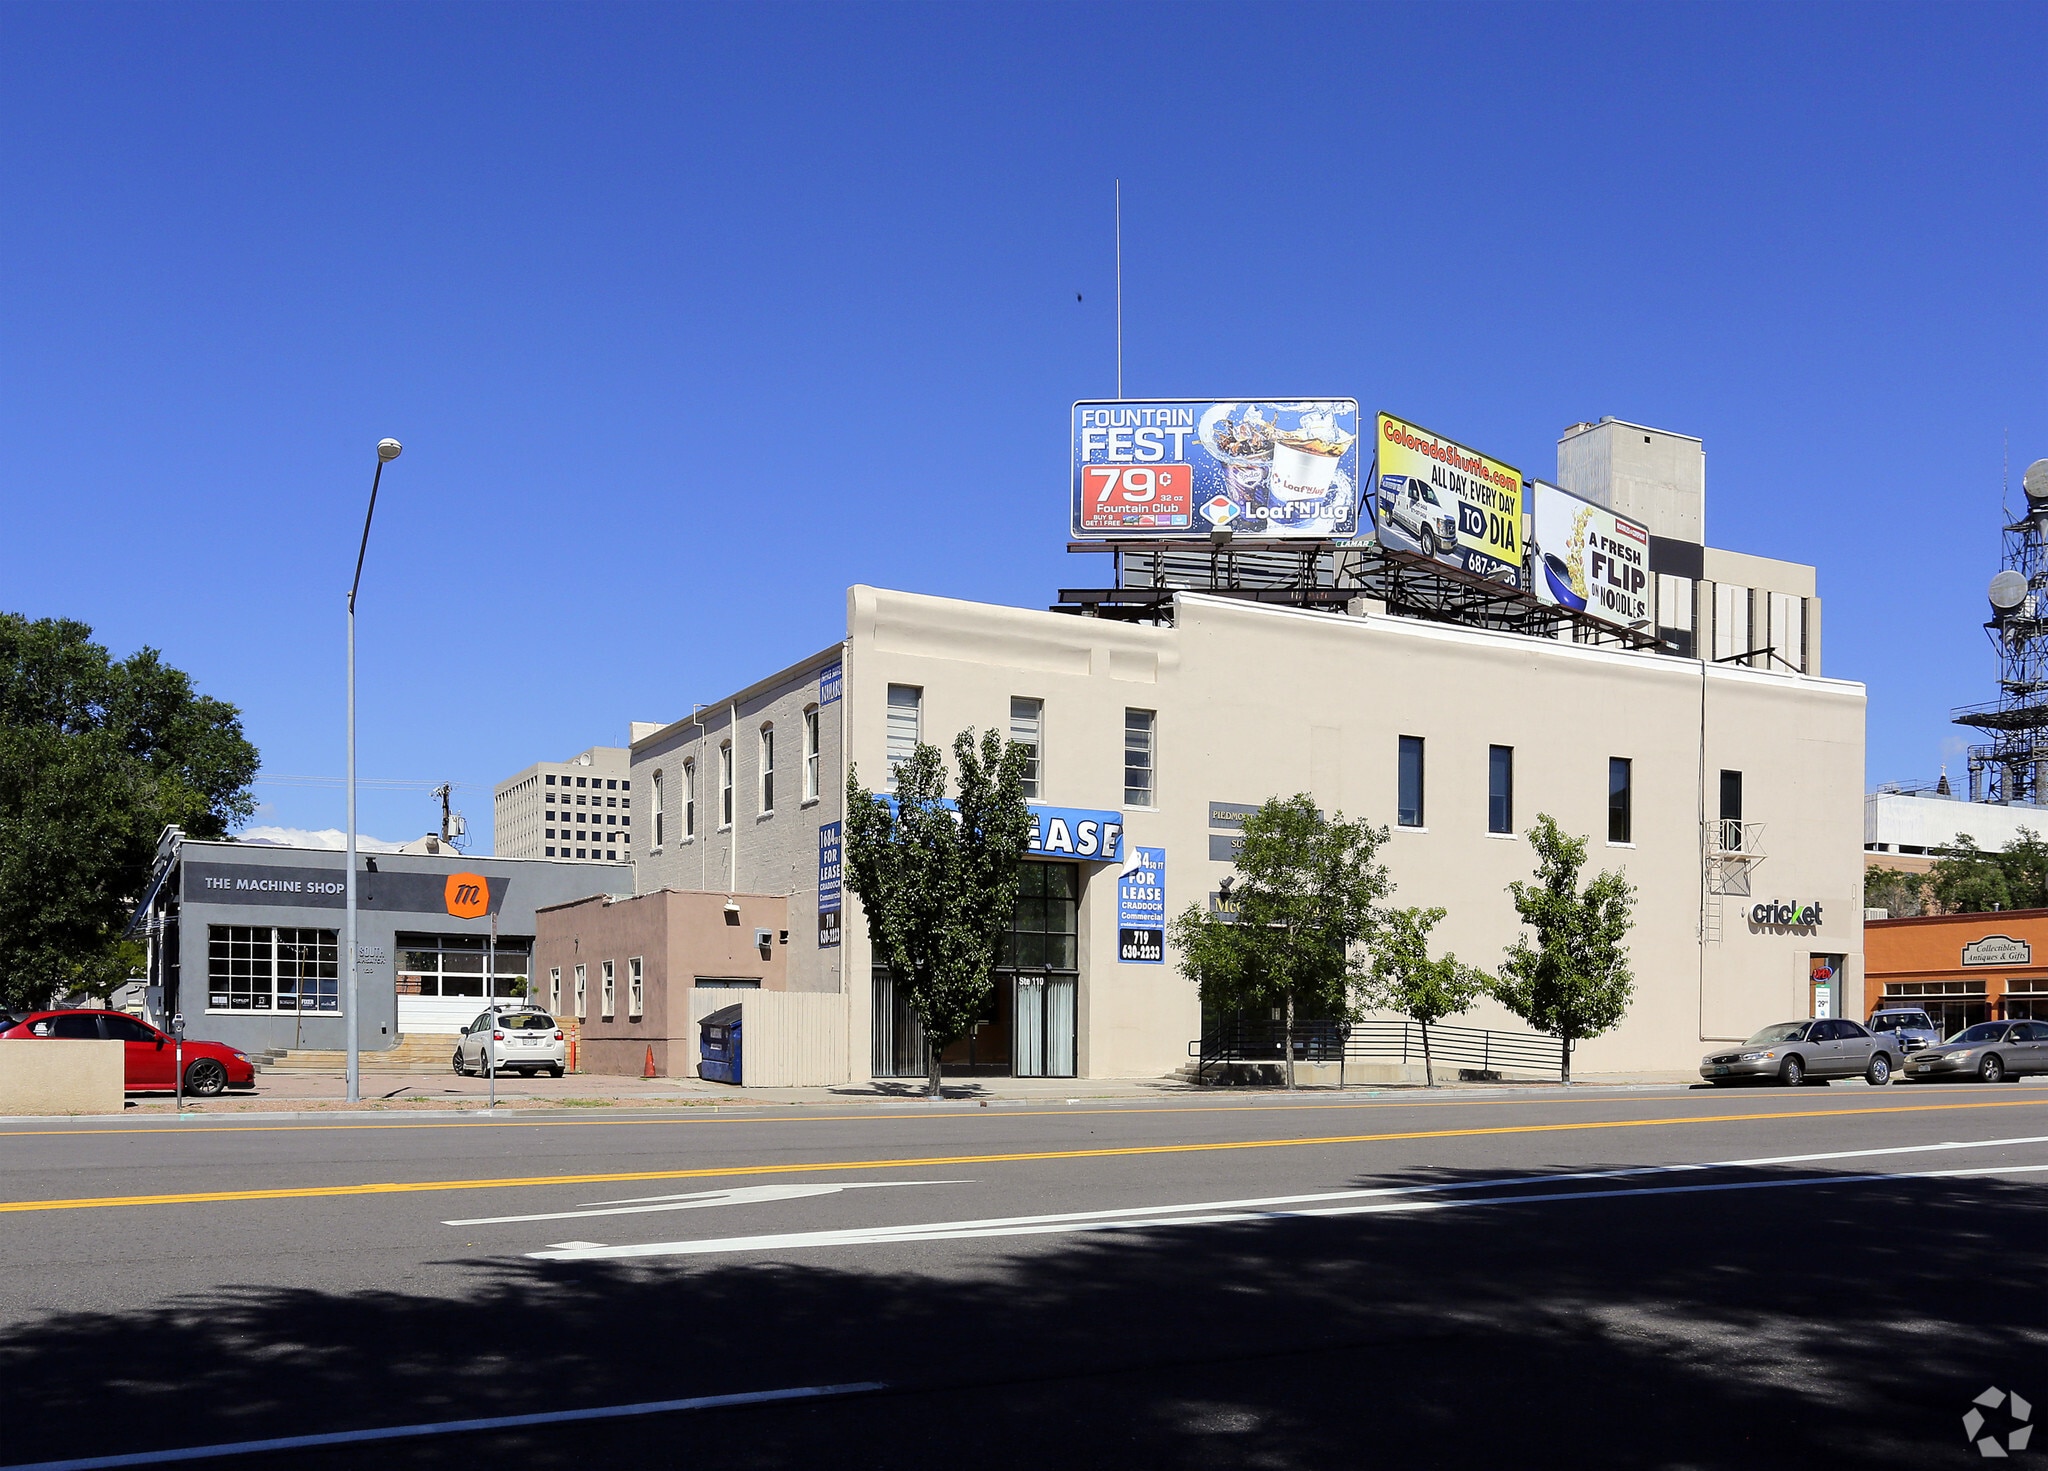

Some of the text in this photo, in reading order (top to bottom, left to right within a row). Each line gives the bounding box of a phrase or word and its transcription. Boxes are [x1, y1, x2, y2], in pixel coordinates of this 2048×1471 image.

[1081, 408, 1195, 428] FOUNTAIN
[1081, 426, 1195, 463] FEST
[1383, 419, 1518, 494] ColoradoShuttle.com
[1160, 494, 1172, 502] 32
[1431, 464, 1516, 517] ALL DAY, EVERY DAY
[1096, 503, 1179, 514] Fountain Club
[1104, 519, 1121, 527] FREE
[1463, 507, 1516, 554] TO DIA
[1340, 539, 1369, 548] LAMAR
[1588, 531, 1642, 566] A FRESH
[1591, 550, 1646, 595] FLIP
[1600, 585, 1646, 620] NOODLES
[1211, 809, 1256, 821] PIEDMOT
[1027, 814, 1123, 859] EASE
[823, 848, 838, 865] FOR
[820, 863, 841, 882] LEASE
[1128, 870, 1156, 885] FOR
[205, 877, 345, 895] THE MACHINE SHOP
[1122, 885, 1162, 901] LEASE
[1121, 901, 1163, 911] CRADDOCK
[1751, 899, 1824, 927] cricket
[1121, 911, 1163, 921] Commercial
[1133, 930, 1150, 945] 719
[1122, 944, 1161, 960] 630-2233
[1976, 943, 2017, 953] Collectibles
[1967, 951, 2026, 963] Antiques & Gifts
[1019, 976, 1044, 986] Ste 110
